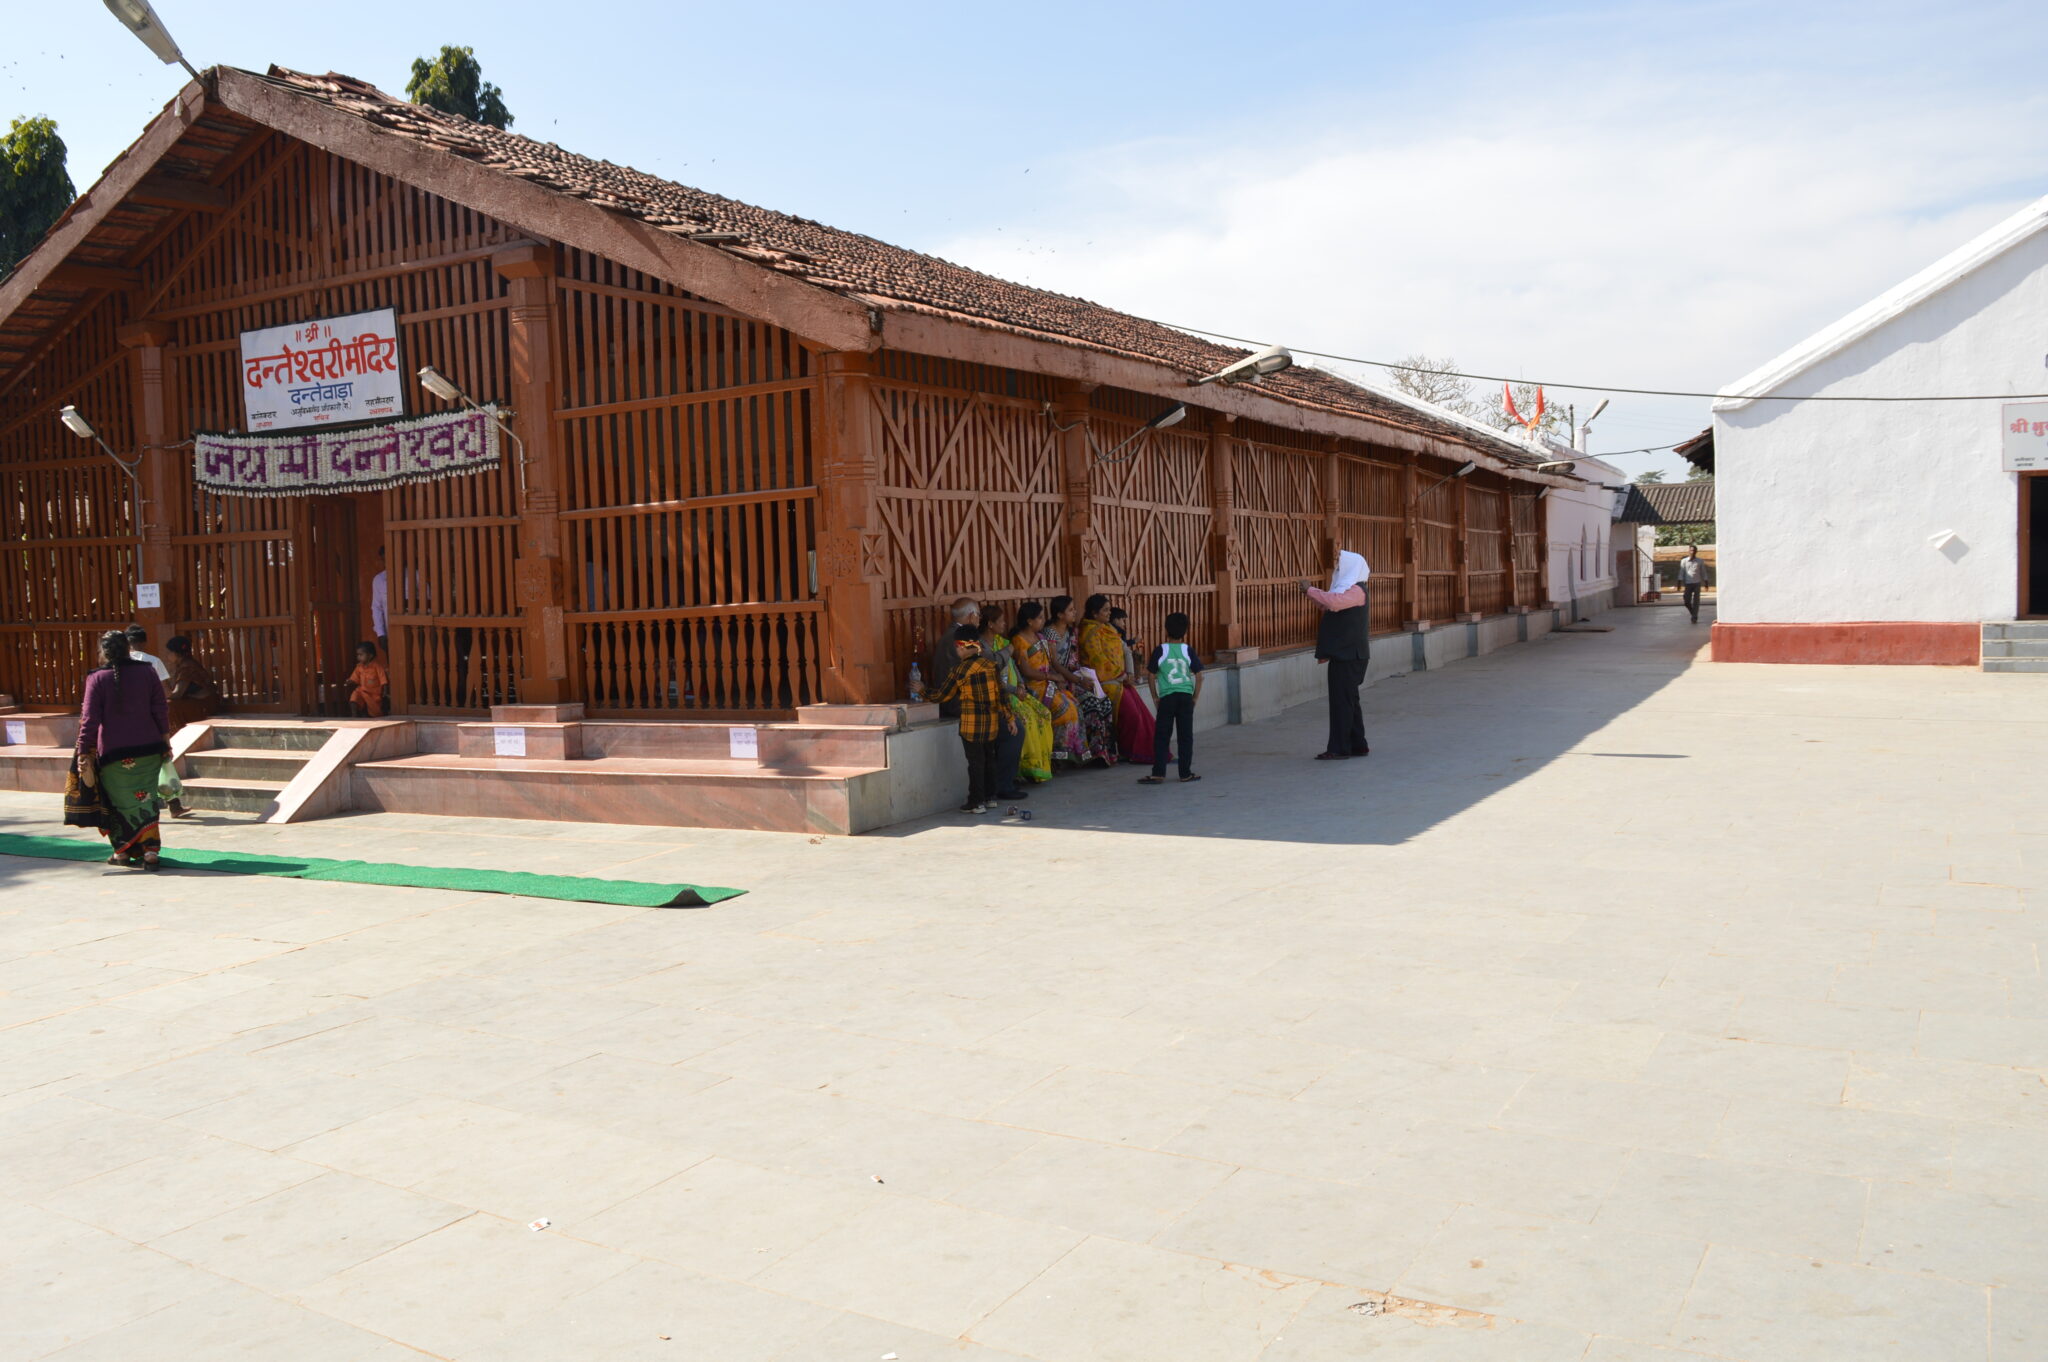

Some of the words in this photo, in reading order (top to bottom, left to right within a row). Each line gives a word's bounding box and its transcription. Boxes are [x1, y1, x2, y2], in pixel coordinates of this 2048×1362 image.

[305, 323, 319, 343] श्री
[288, 382, 354, 405] दन्तेवाड़ा
[2010, 418, 2029, 433] श्री
[200, 441, 268, 484] जय
